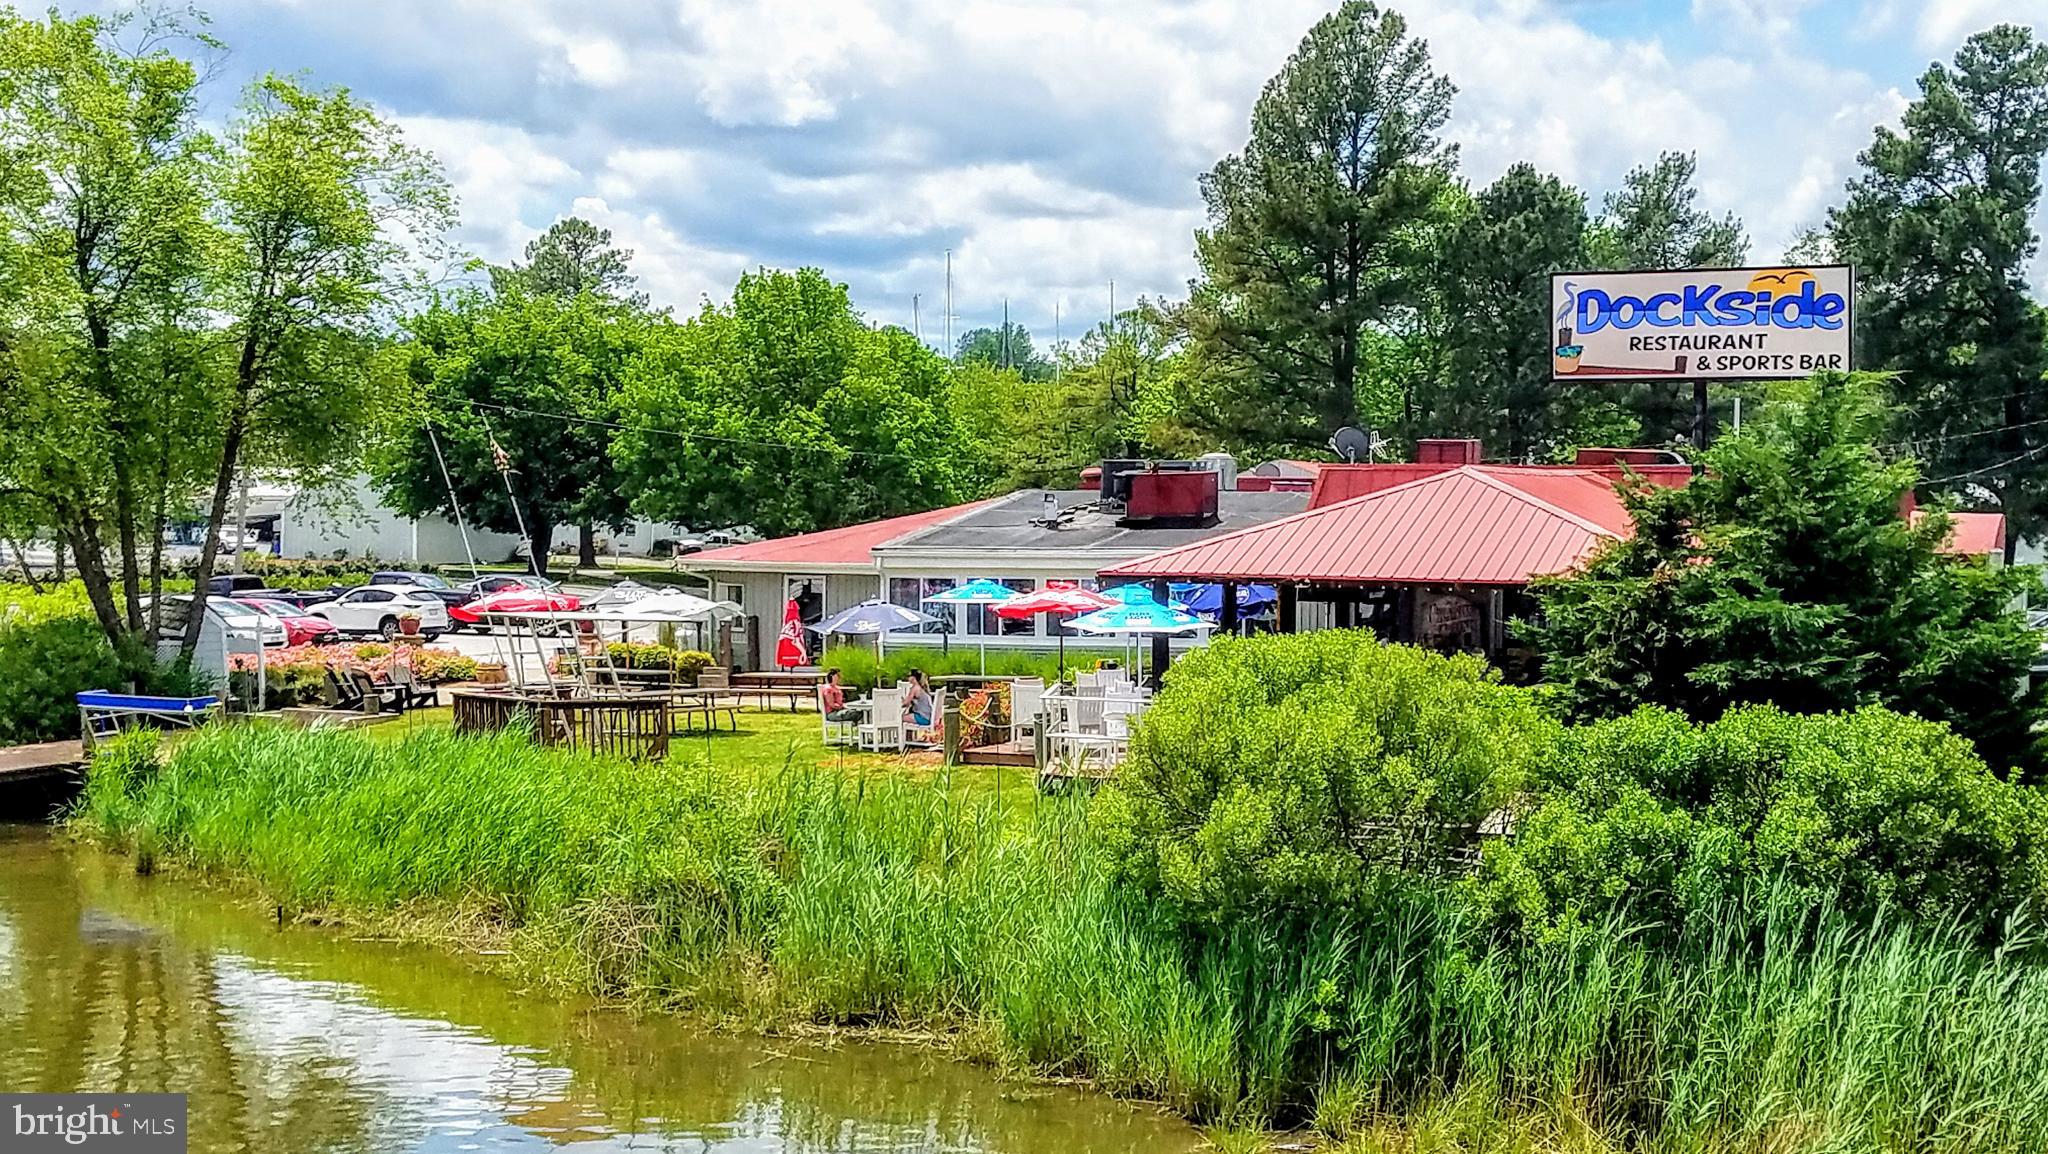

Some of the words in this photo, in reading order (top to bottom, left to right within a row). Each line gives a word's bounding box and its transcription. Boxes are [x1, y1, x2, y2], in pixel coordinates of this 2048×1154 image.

[1629, 333, 1767, 351] RESTAURANT
[1696, 356, 1711, 370] &
[1717, 355, 1793, 370] SPORTS
[1800, 353, 1842, 369] BAR
